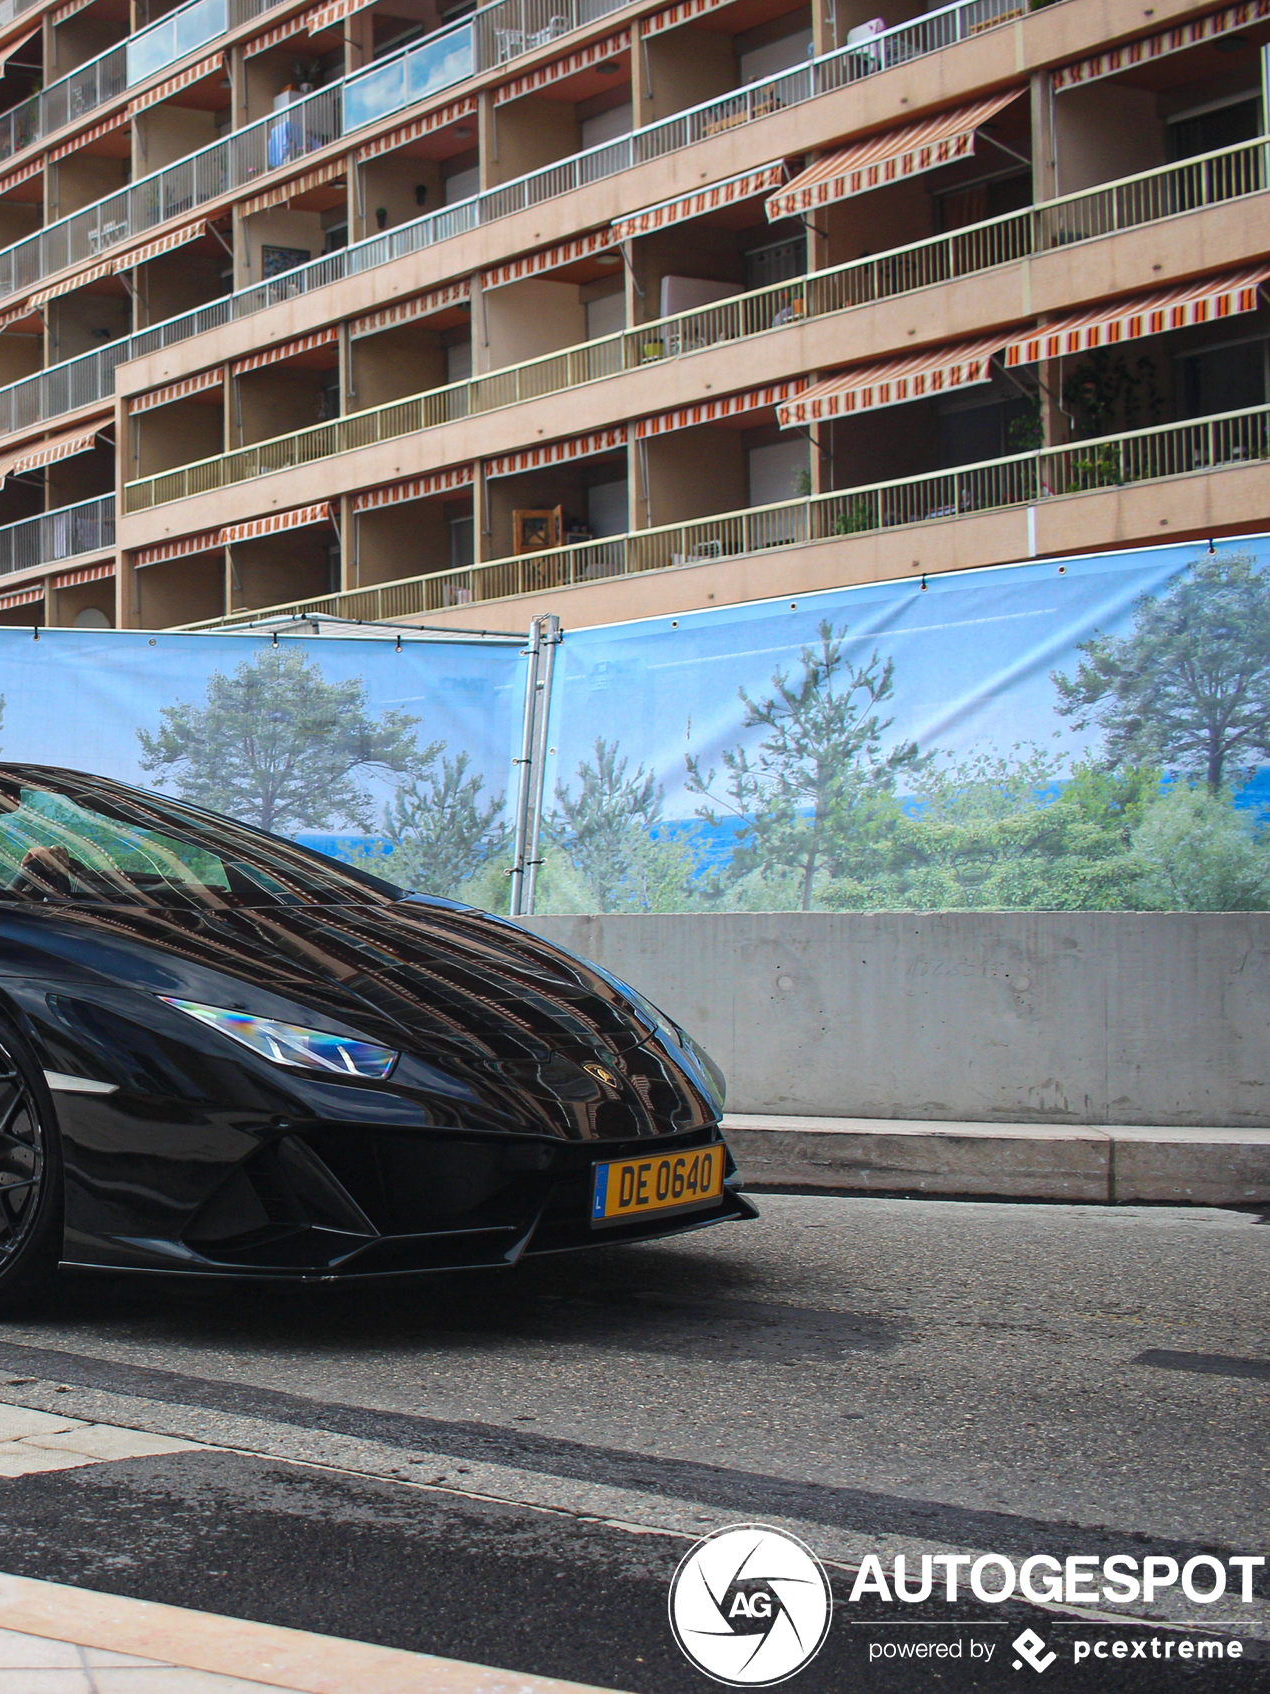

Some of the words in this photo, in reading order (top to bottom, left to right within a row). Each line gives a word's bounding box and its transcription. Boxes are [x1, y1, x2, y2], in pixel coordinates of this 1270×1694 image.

[619, 1163, 652, 1208] DE
[656, 1153, 712, 1201] 0640
[596, 1196, 601, 1210] L
